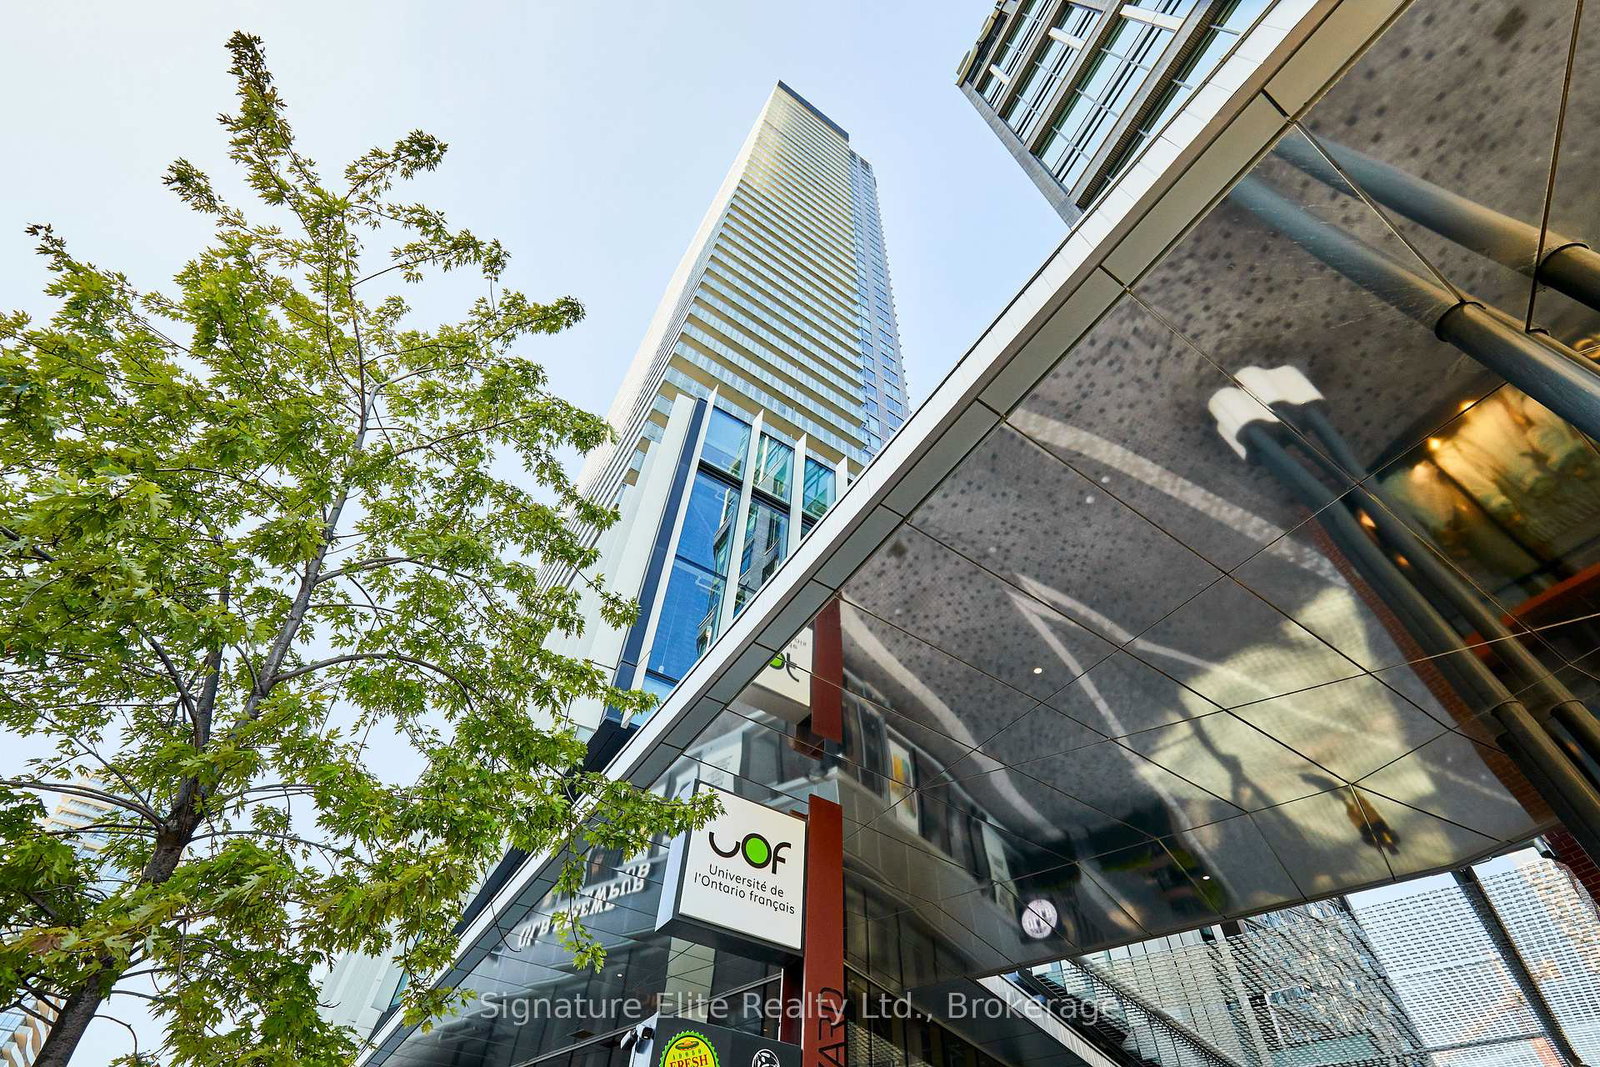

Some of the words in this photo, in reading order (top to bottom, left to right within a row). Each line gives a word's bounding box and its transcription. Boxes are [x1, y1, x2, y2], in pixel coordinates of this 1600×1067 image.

[694, 872, 746, 899] l'Ontario
[749, 890, 795, 915] français
[709, 864, 766, 892] Université
[770, 885, 784, 897] de
[817, 986, 847, 1067] ARD
